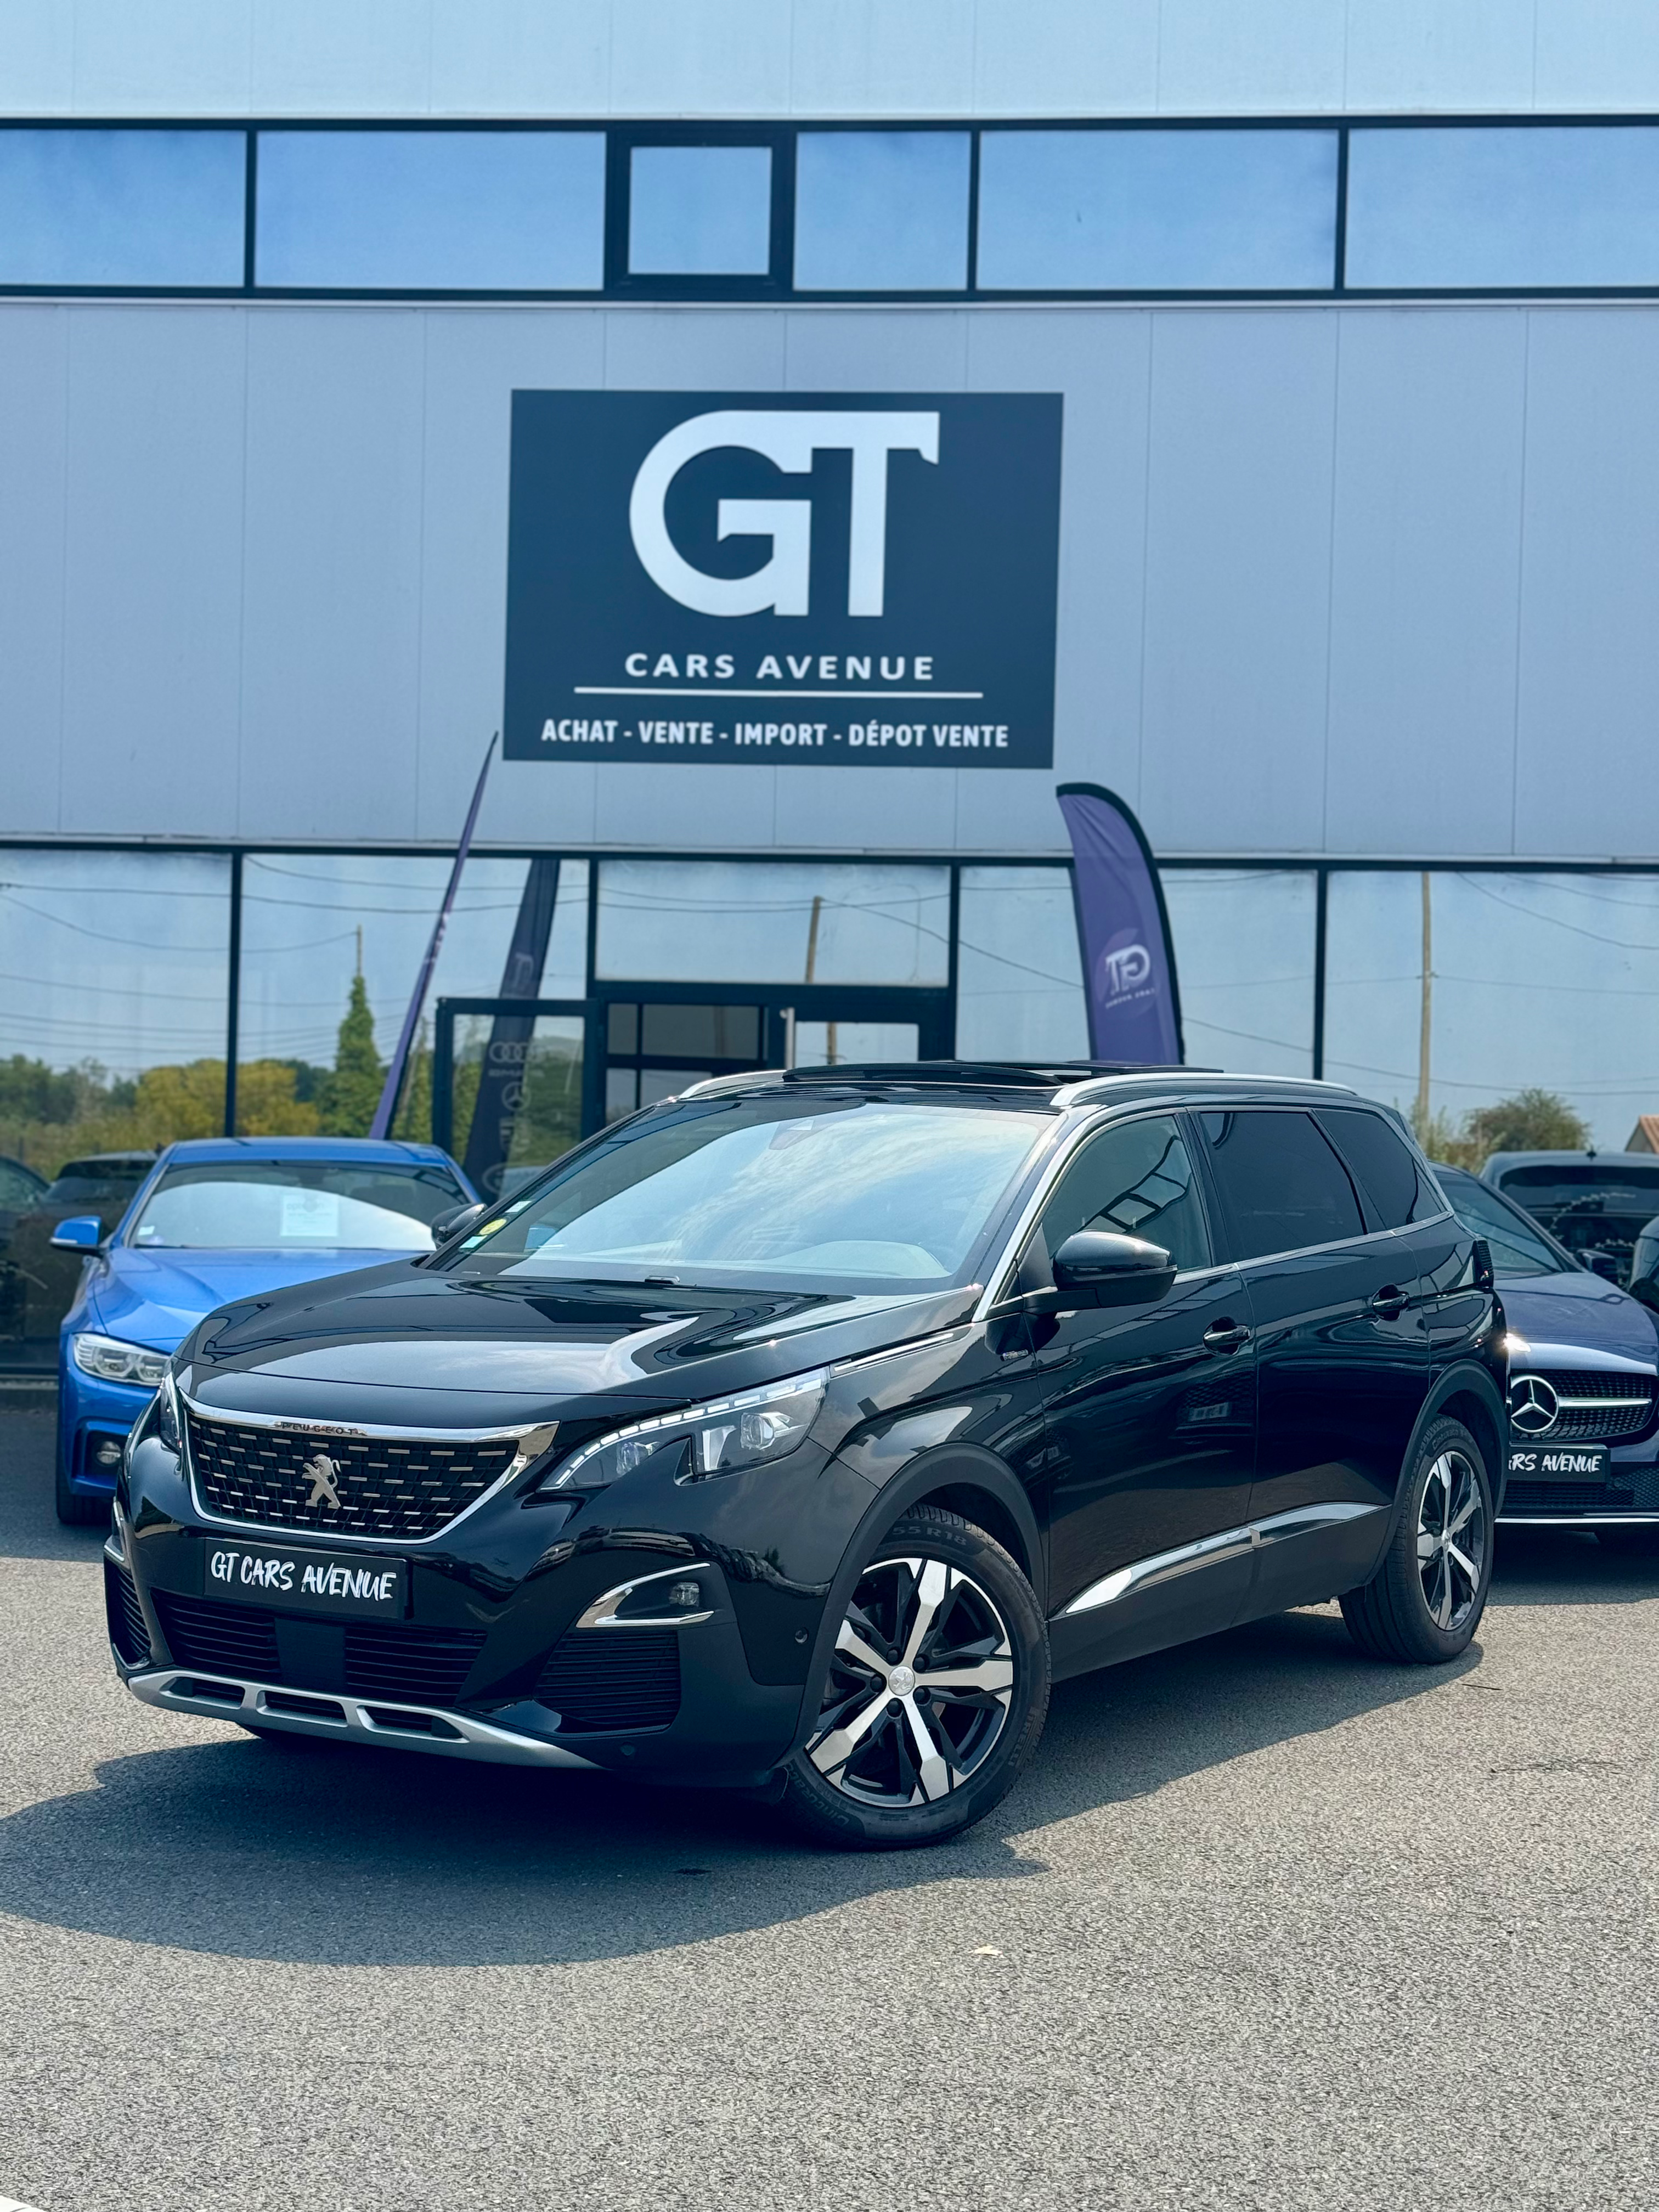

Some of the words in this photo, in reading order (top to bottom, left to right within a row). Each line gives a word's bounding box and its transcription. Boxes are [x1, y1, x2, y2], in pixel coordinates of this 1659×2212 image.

[629, 410, 940, 617] GT
[625, 653, 735, 678] CARS
[757, 655, 934, 680] AVENUE
[541, 719, 618, 742] ACHAT
[639, 721, 713, 744] VENTE
[735, 723, 827, 746] IMPORT
[849, 720, 927, 747] DÉPOT
[933, 725, 1008, 747] VENTE
[281, 1421, 356, 1435] PEUGEOT
[1541, 1451, 1602, 1473] AVENUE
[926, 1527, 967, 1545] R18
[211, 1551, 240, 1583] GT
[240, 1555, 296, 1591] CARS
[301, 1562, 397, 1601] AVENUE
